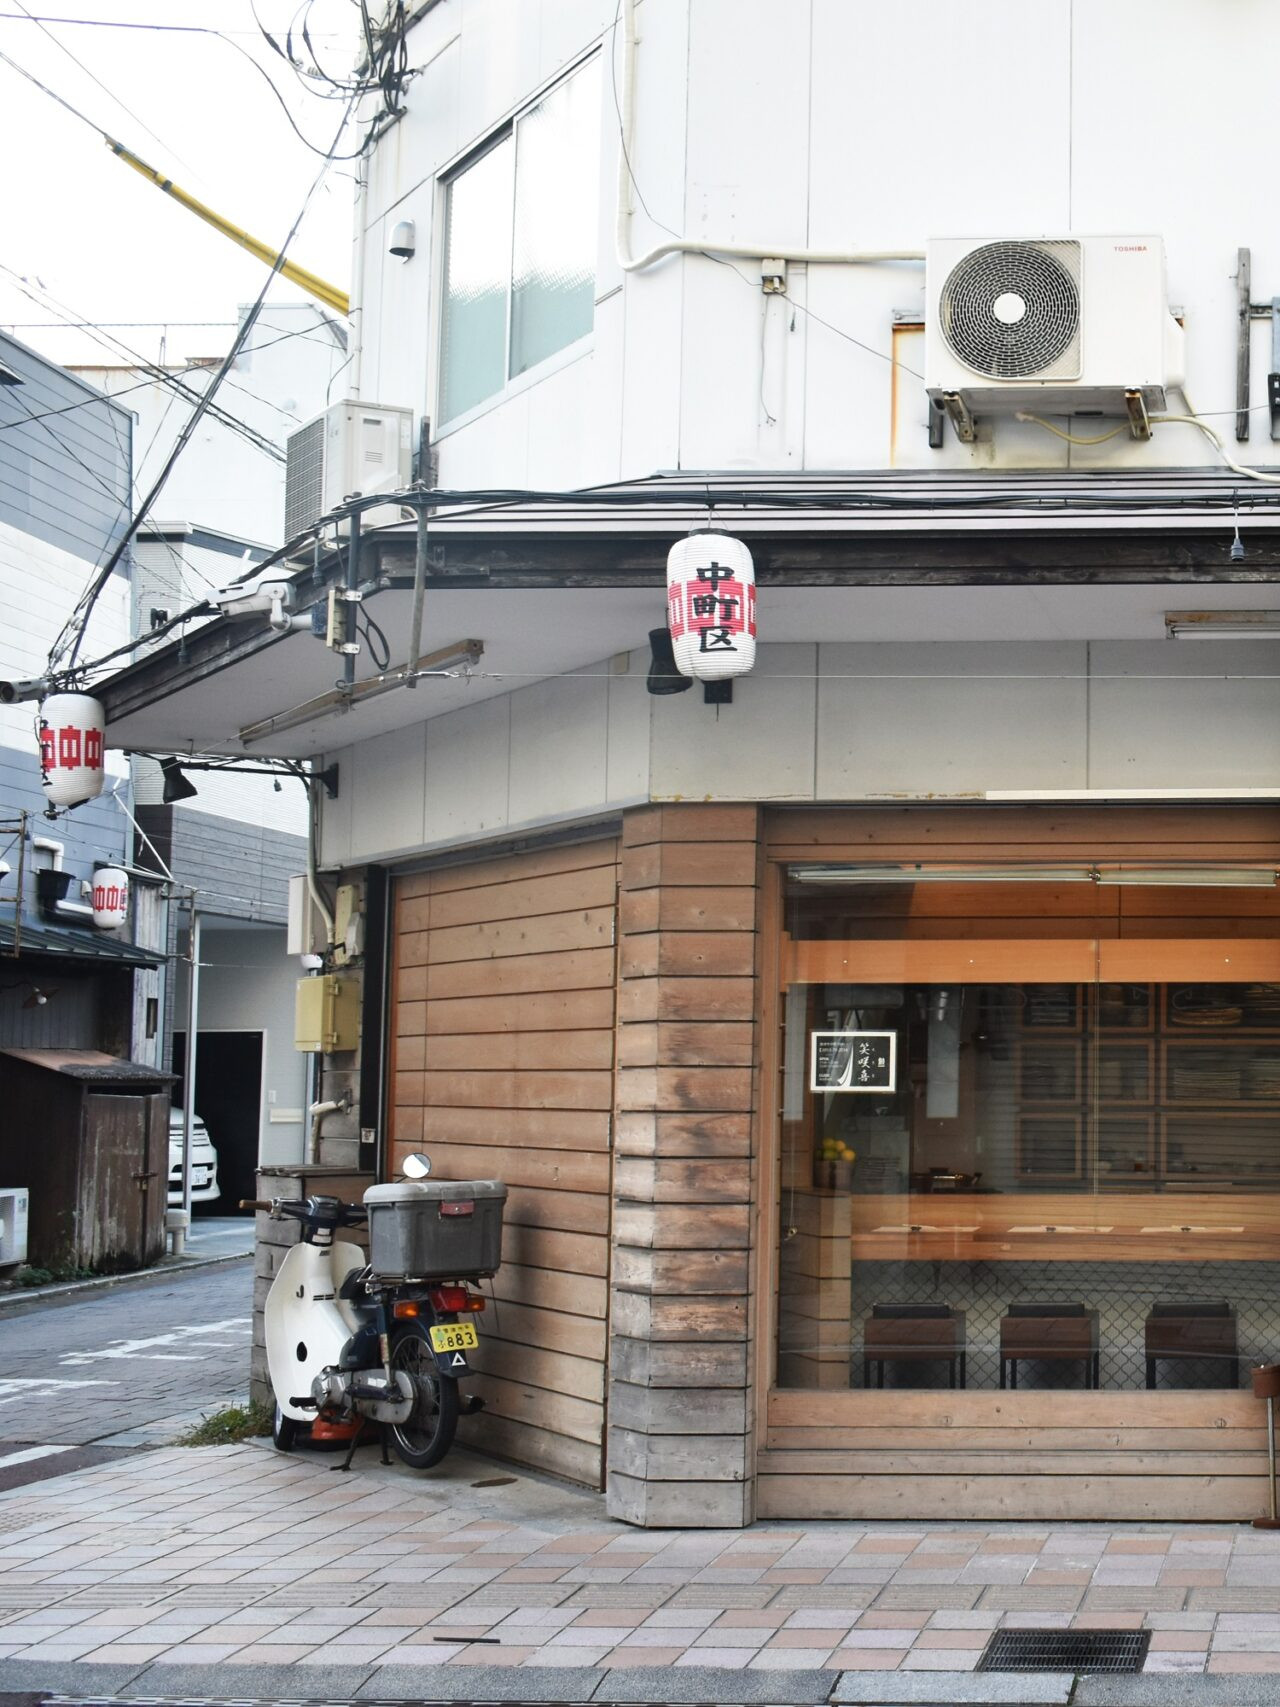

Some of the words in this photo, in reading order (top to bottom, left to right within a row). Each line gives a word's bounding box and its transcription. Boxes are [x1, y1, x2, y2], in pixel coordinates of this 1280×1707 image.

[693, 561, 739, 653] 中町区
[447, 1332, 473, 1347] 883
